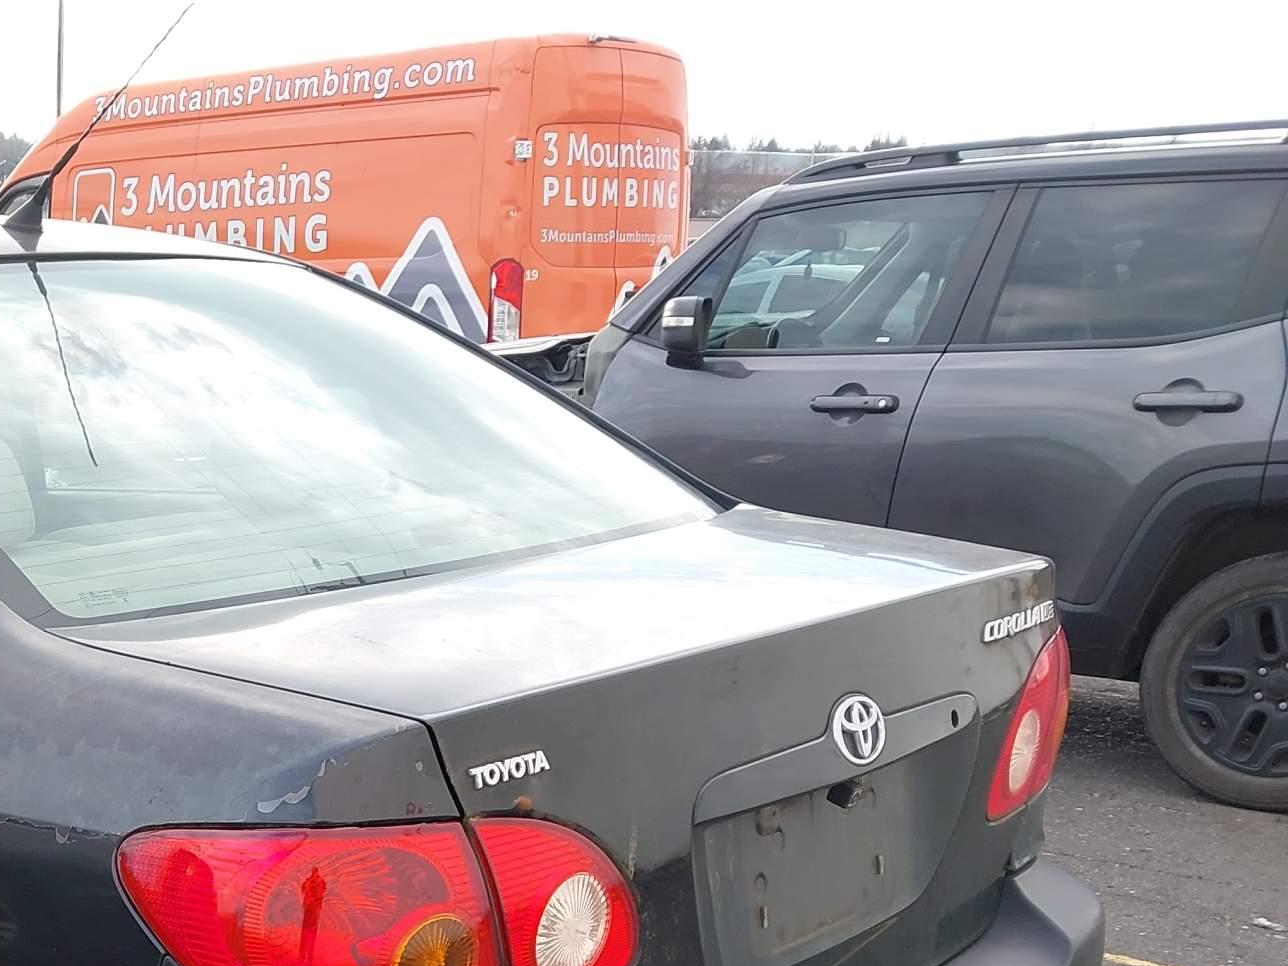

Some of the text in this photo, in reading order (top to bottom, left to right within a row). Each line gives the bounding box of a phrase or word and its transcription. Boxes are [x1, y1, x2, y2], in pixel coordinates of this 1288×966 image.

[91, 56, 475, 124] 3MountainsPlumbing.com
[543, 131, 680, 172] 3 Mountains
[121, 162, 332, 217] 3 Mountains
[542, 176, 678, 209] PLUMBING
[526, 269, 539, 281] 19
[982, 605, 1041, 643] COROLLA
[468, 750, 551, 790] TOYOTA
